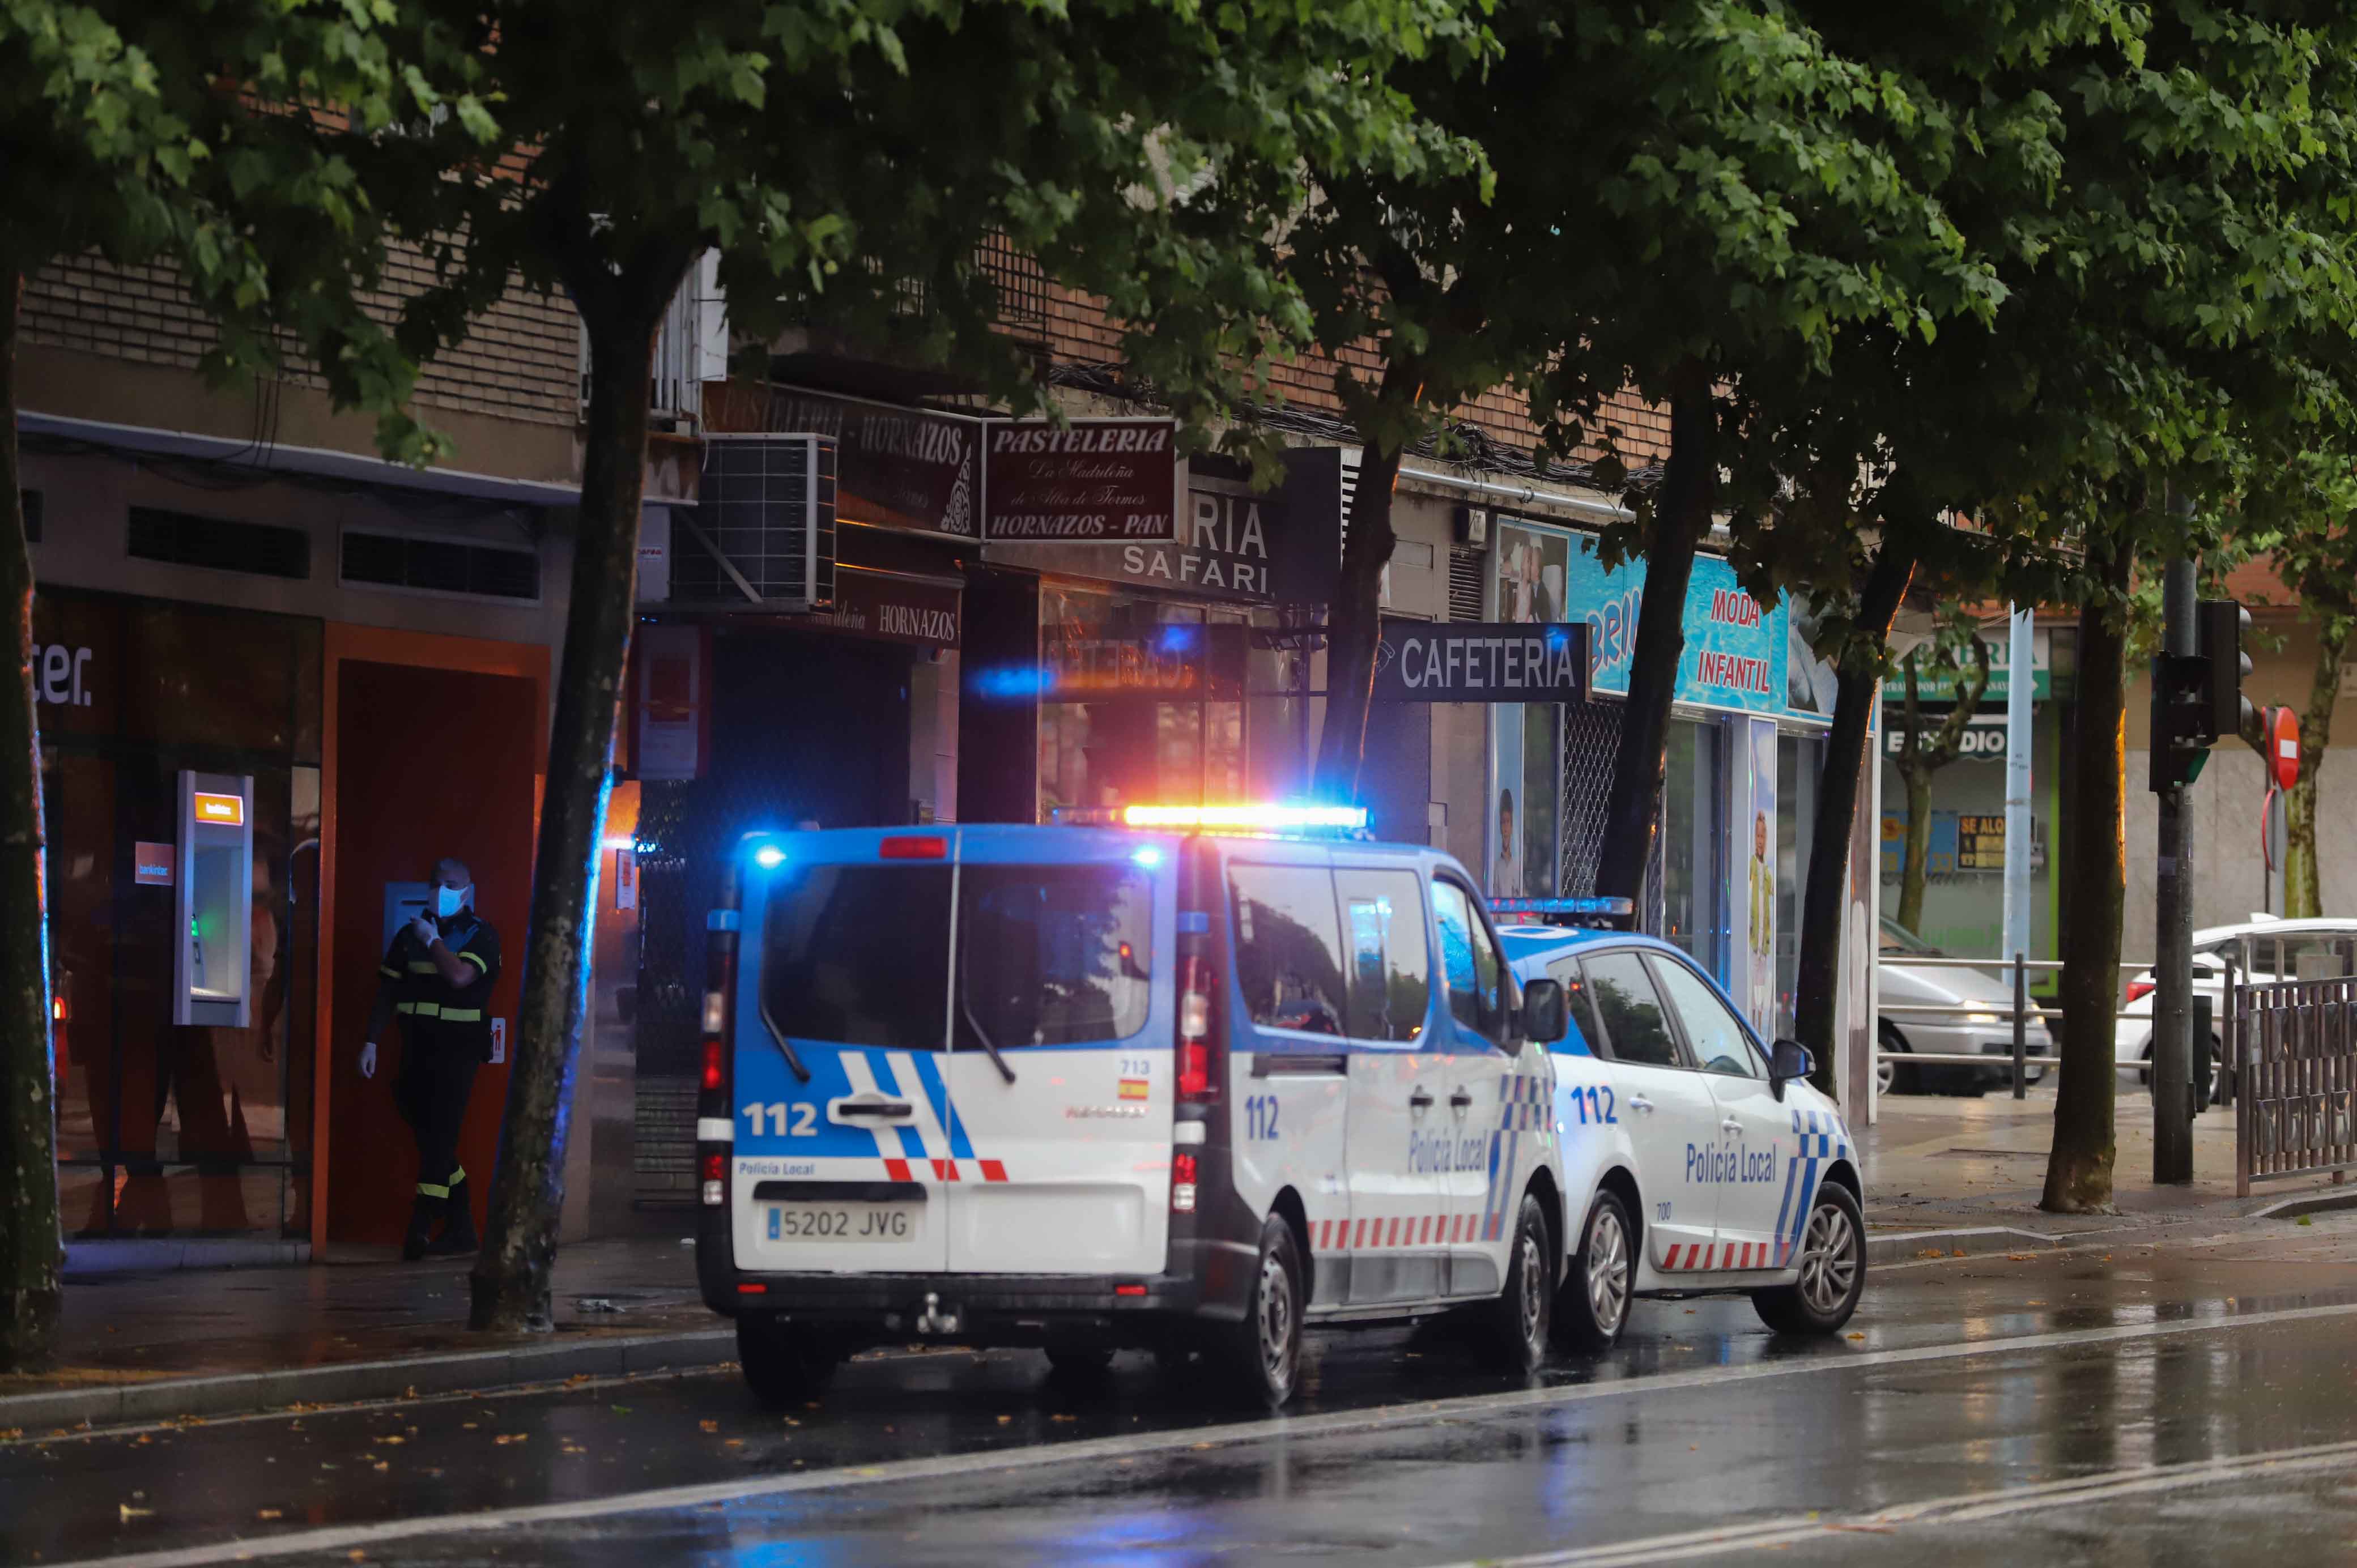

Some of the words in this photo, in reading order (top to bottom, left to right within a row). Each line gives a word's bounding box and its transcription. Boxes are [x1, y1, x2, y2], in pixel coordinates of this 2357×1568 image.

[860, 416, 961, 466] HORNAZOS
[993, 428, 1168, 453] PASTELERIA
[1096, 485, 1147, 505] Tormes
[992, 514, 1105, 535] HORNAZOS
[1124, 514, 1169, 534] PAN
[1124, 546, 1267, 594] SAFARI
[879, 604, 956, 641] HORNAZOS
[1710, 589, 1760, 628] MODA
[1401, 631, 1576, 688] CAFETERÍA
[1697, 651, 1769, 692] INFANTIL
[1918, 681, 1935, 692] POR
[1121, 1059, 1150, 1075] 713
[742, 1102, 818, 1136] 112
[1246, 1095, 1279, 1140] 112
[1570, 1086, 1618, 1124] 112
[782, 1162, 815, 1174] Local
[1454, 1130, 1487, 1172] Local
[1686, 1142, 1735, 1183] Policía
[1741, 1143, 1776, 1183] Local
[784, 1211, 848, 1235] 5202
[859, 1211, 907, 1235] JVG
[1657, 1201, 1671, 1221] 700
